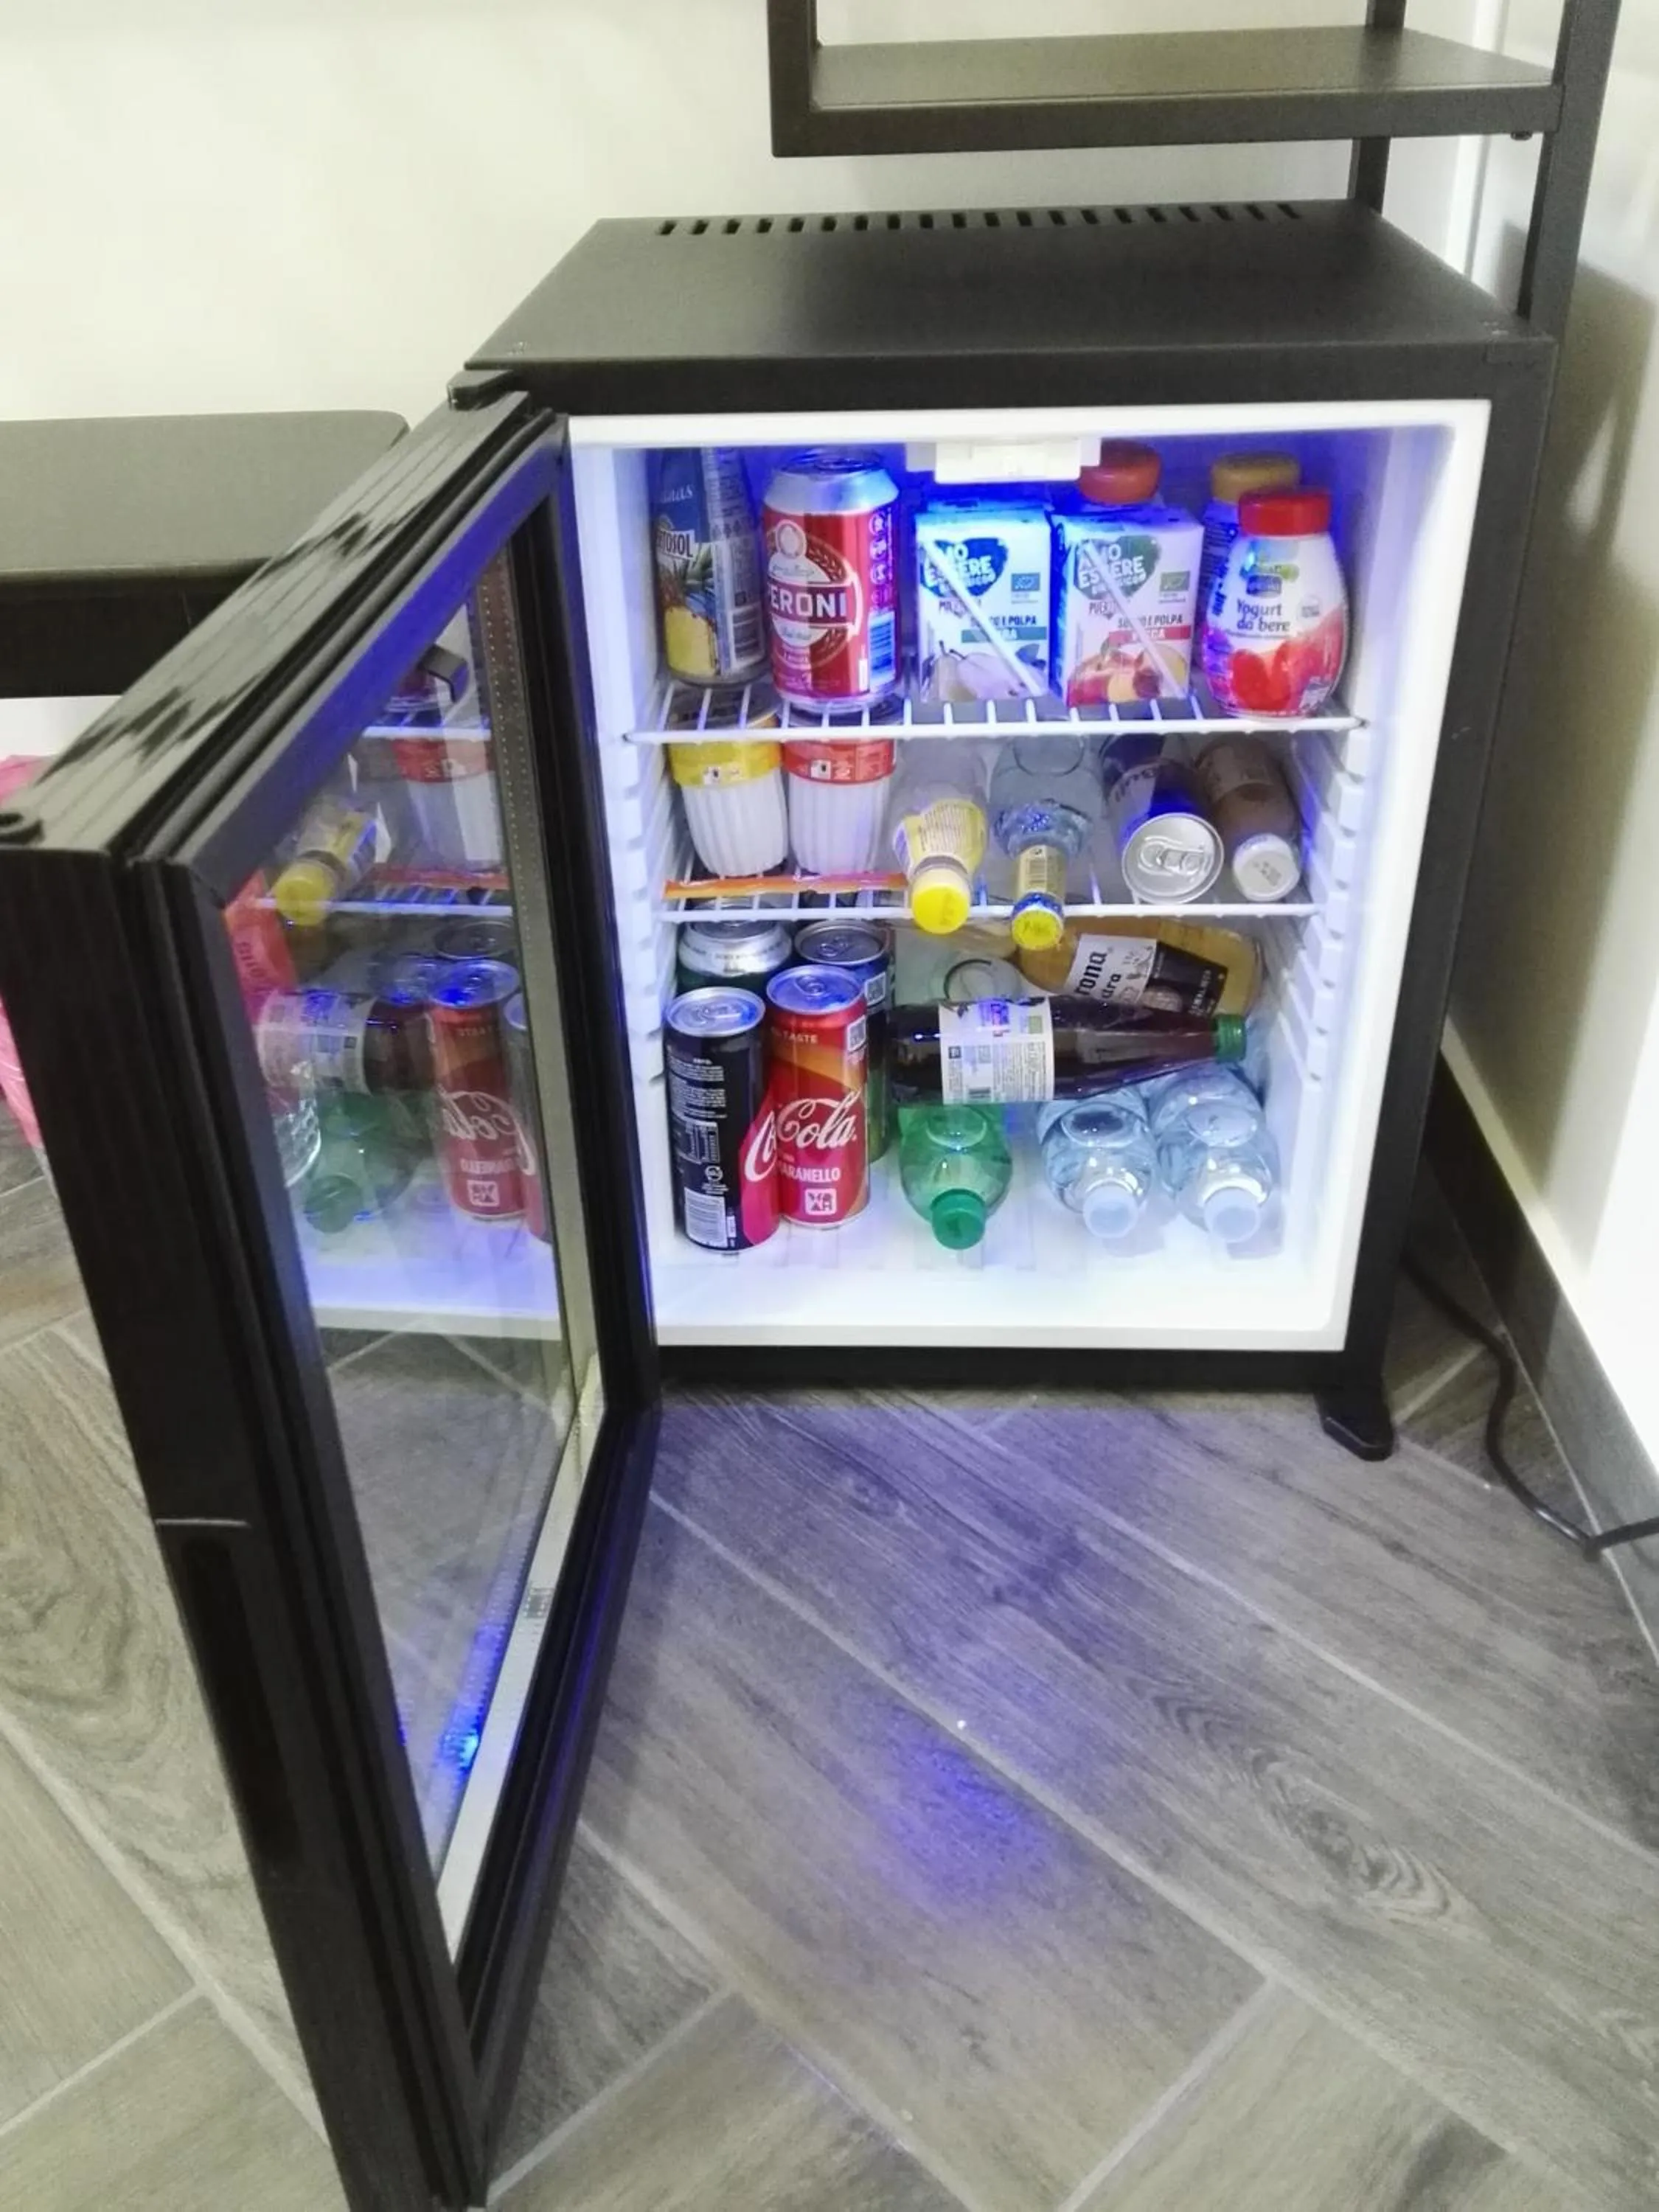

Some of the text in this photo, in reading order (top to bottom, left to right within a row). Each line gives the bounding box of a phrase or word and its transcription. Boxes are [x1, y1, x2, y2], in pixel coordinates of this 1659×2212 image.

[768, 585, 846, 618] ERONI
[1237, 598, 1282, 622] Yogurt
[1259, 618, 1290, 631] bere
[1074, 951, 1108, 996] rona
[776, 1090, 861, 1150] Cola
